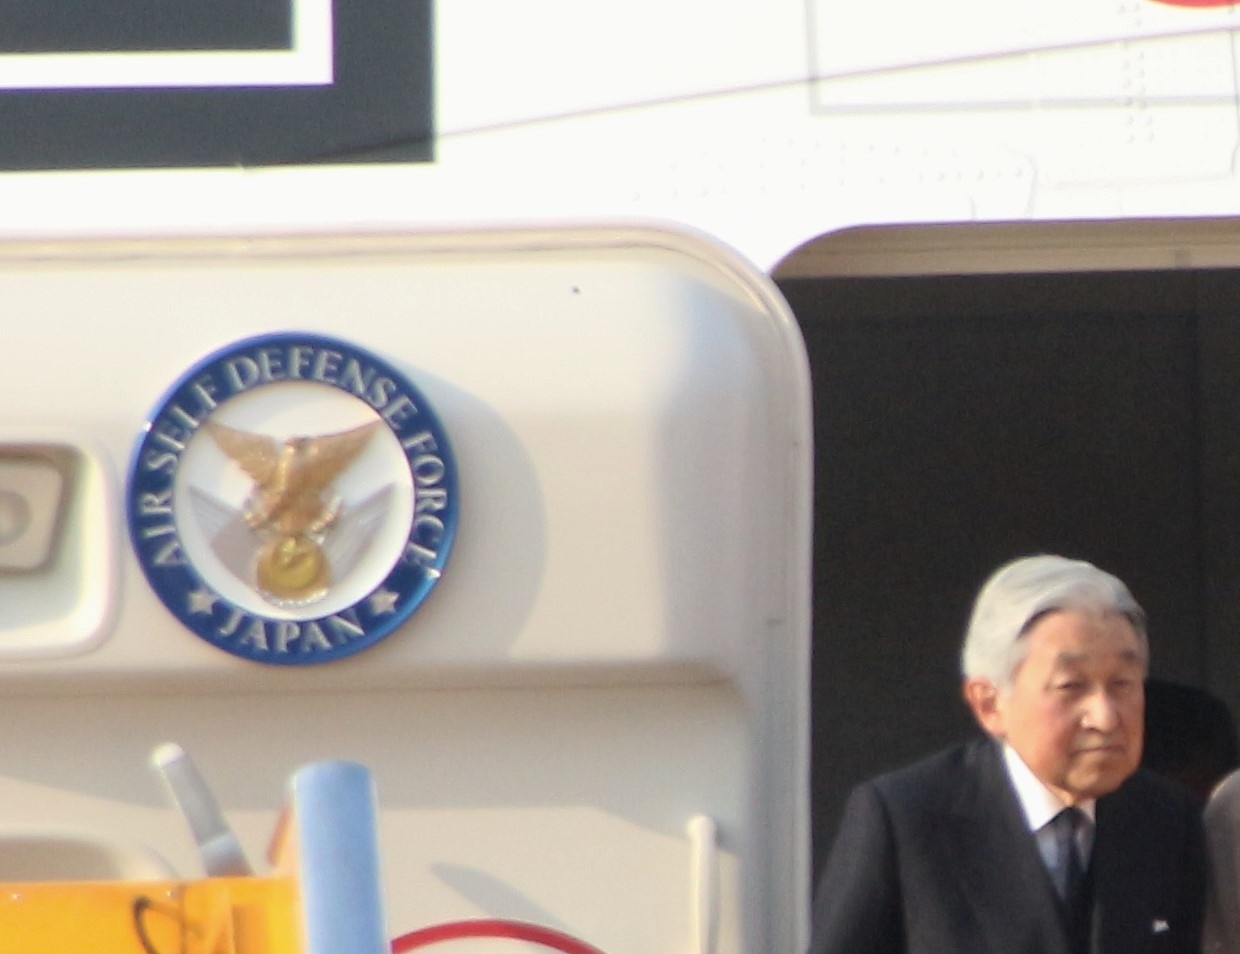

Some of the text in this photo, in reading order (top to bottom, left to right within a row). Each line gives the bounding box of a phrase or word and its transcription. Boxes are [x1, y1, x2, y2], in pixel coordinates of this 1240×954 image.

[143, 346, 448, 567] AIR SELF DEFENSE FORCE
[218, 608, 366, 653] JAPAN
